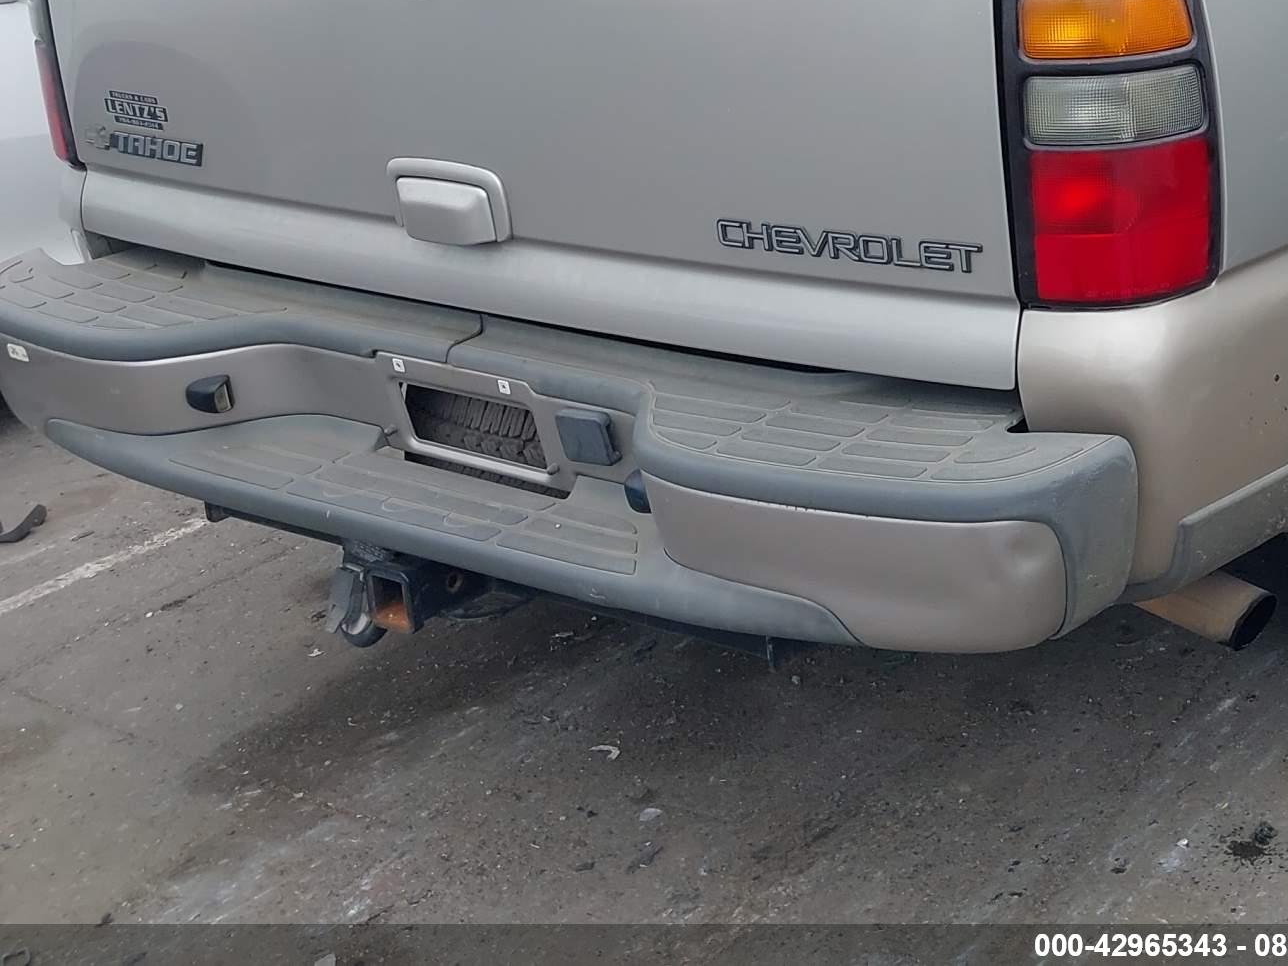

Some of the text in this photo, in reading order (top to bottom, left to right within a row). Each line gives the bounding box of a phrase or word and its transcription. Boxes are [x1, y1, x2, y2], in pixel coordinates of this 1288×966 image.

[106, 98, 166, 122] LENTZ'S
[112, 130, 203, 166] TAHOE
[715, 218, 983, 274] CHEVROLET
